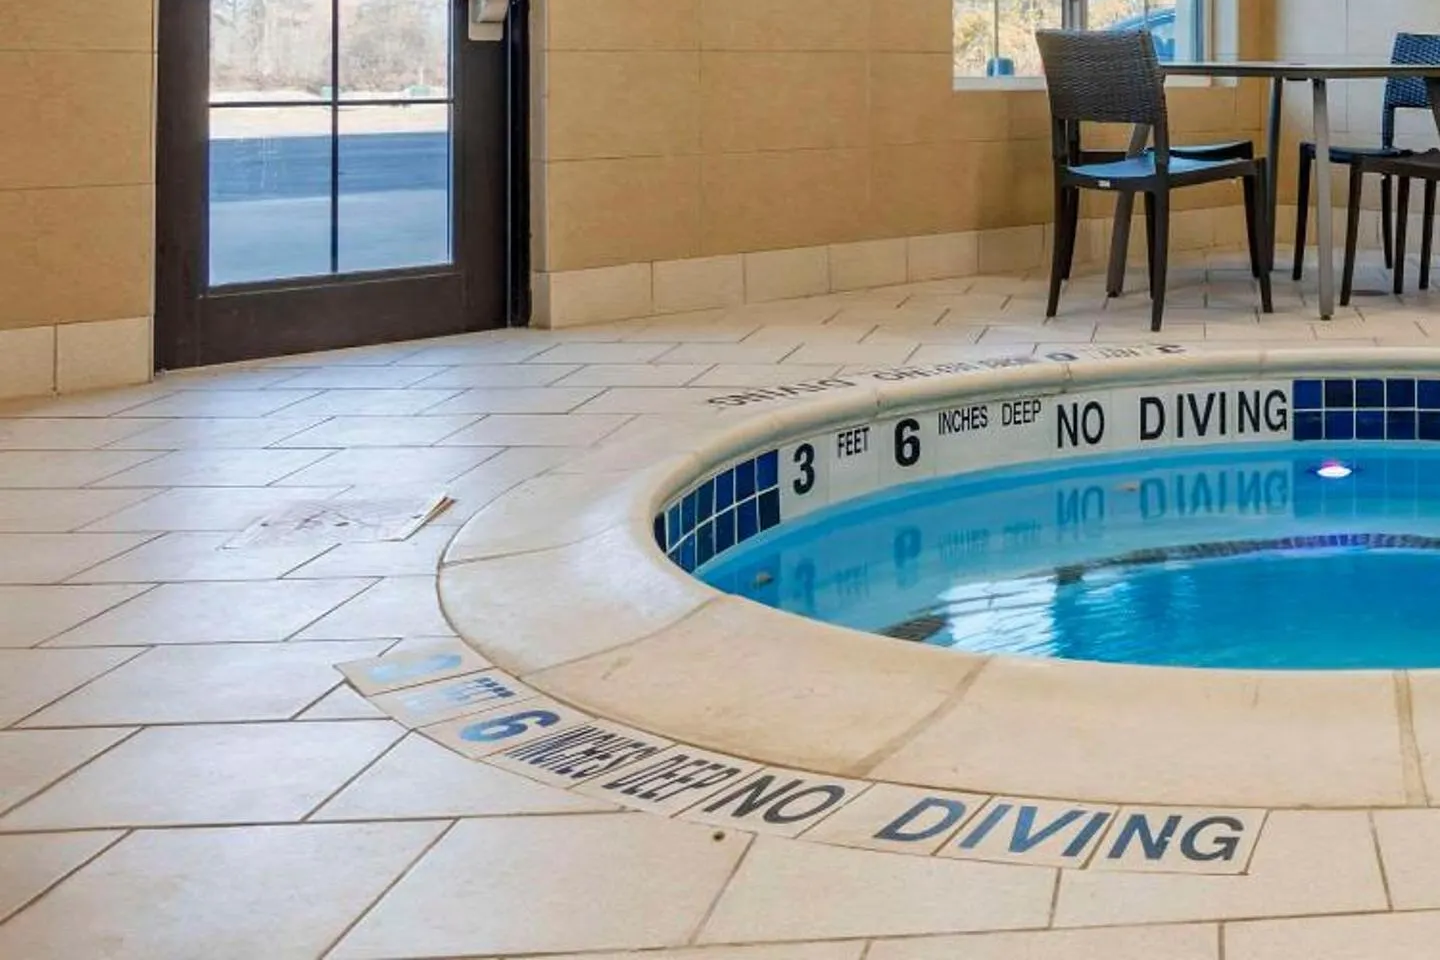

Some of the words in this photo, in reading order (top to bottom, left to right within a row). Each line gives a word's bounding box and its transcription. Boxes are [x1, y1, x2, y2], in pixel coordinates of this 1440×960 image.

[793, 443, 815, 495] 3
[837, 426, 870, 458] FEET
[894, 418, 921, 467] 6
[938, 405, 988, 435] INCHES
[1002, 399, 1042, 426] DEEP
[1056, 401, 1105, 449] NO
[1139, 389, 1288, 441] DIVING
[459, 710, 561, 743] 6
[505, 724, 659, 780] INCHES
[602, 753, 742, 803] DEEP
[702, 775, 847, 825] NO
[873, 797, 1245, 862] DIVING
